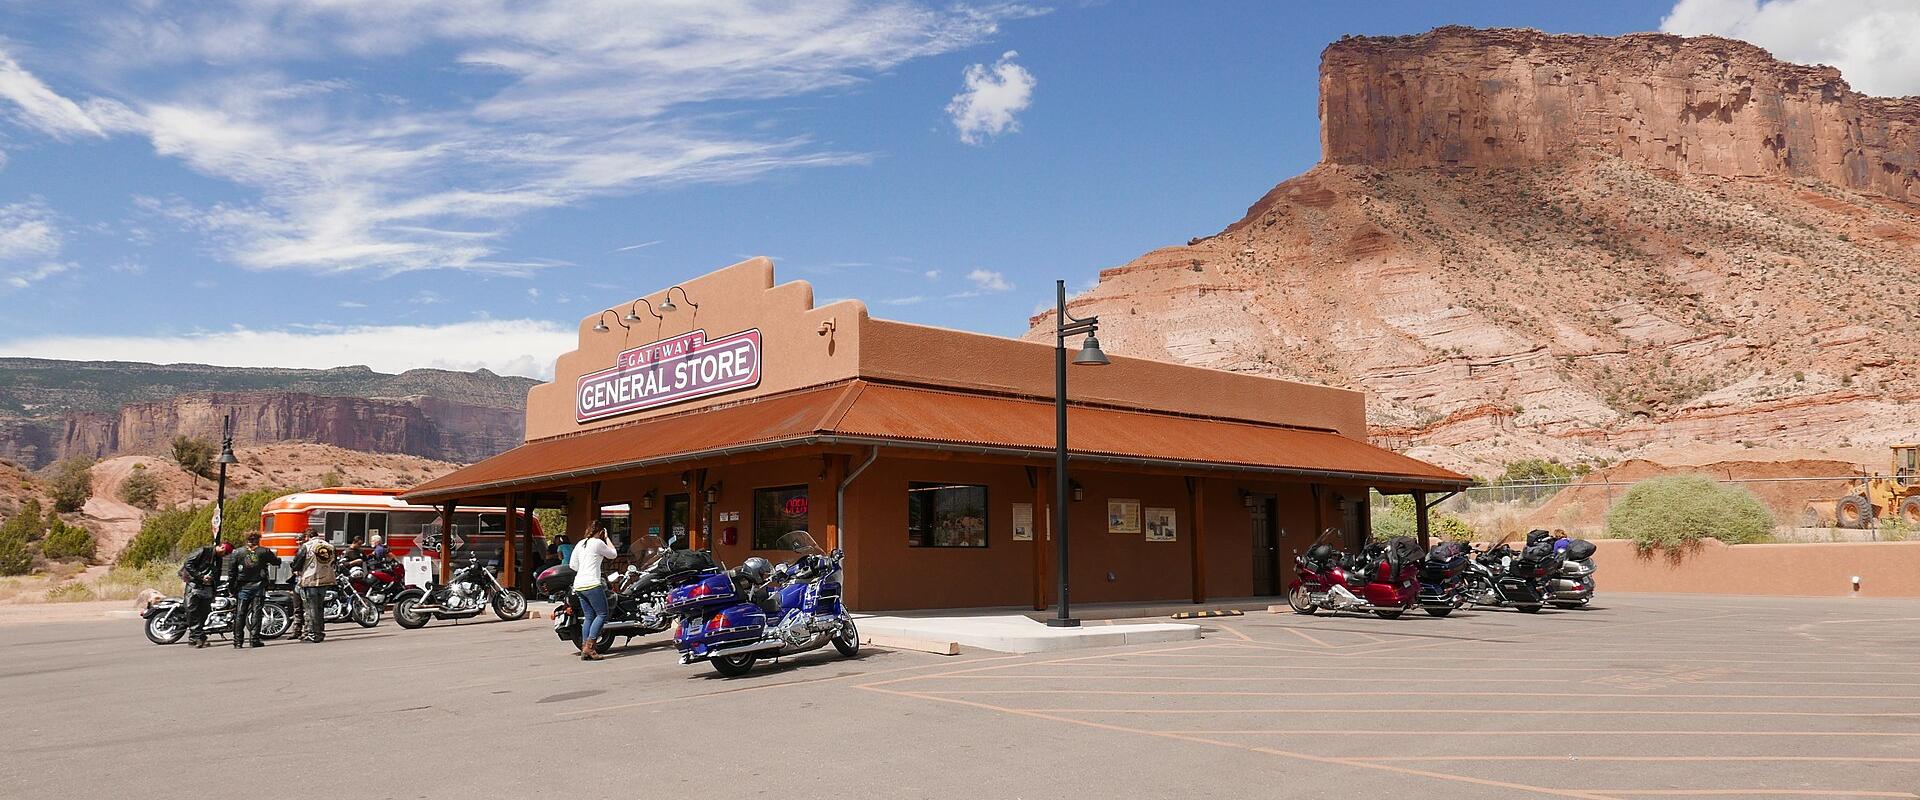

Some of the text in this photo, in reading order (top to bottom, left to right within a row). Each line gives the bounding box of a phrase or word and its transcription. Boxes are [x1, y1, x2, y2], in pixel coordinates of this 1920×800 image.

[628, 339, 691, 366] GATEWAY
[582, 345, 750, 410] GENERAL STORE
